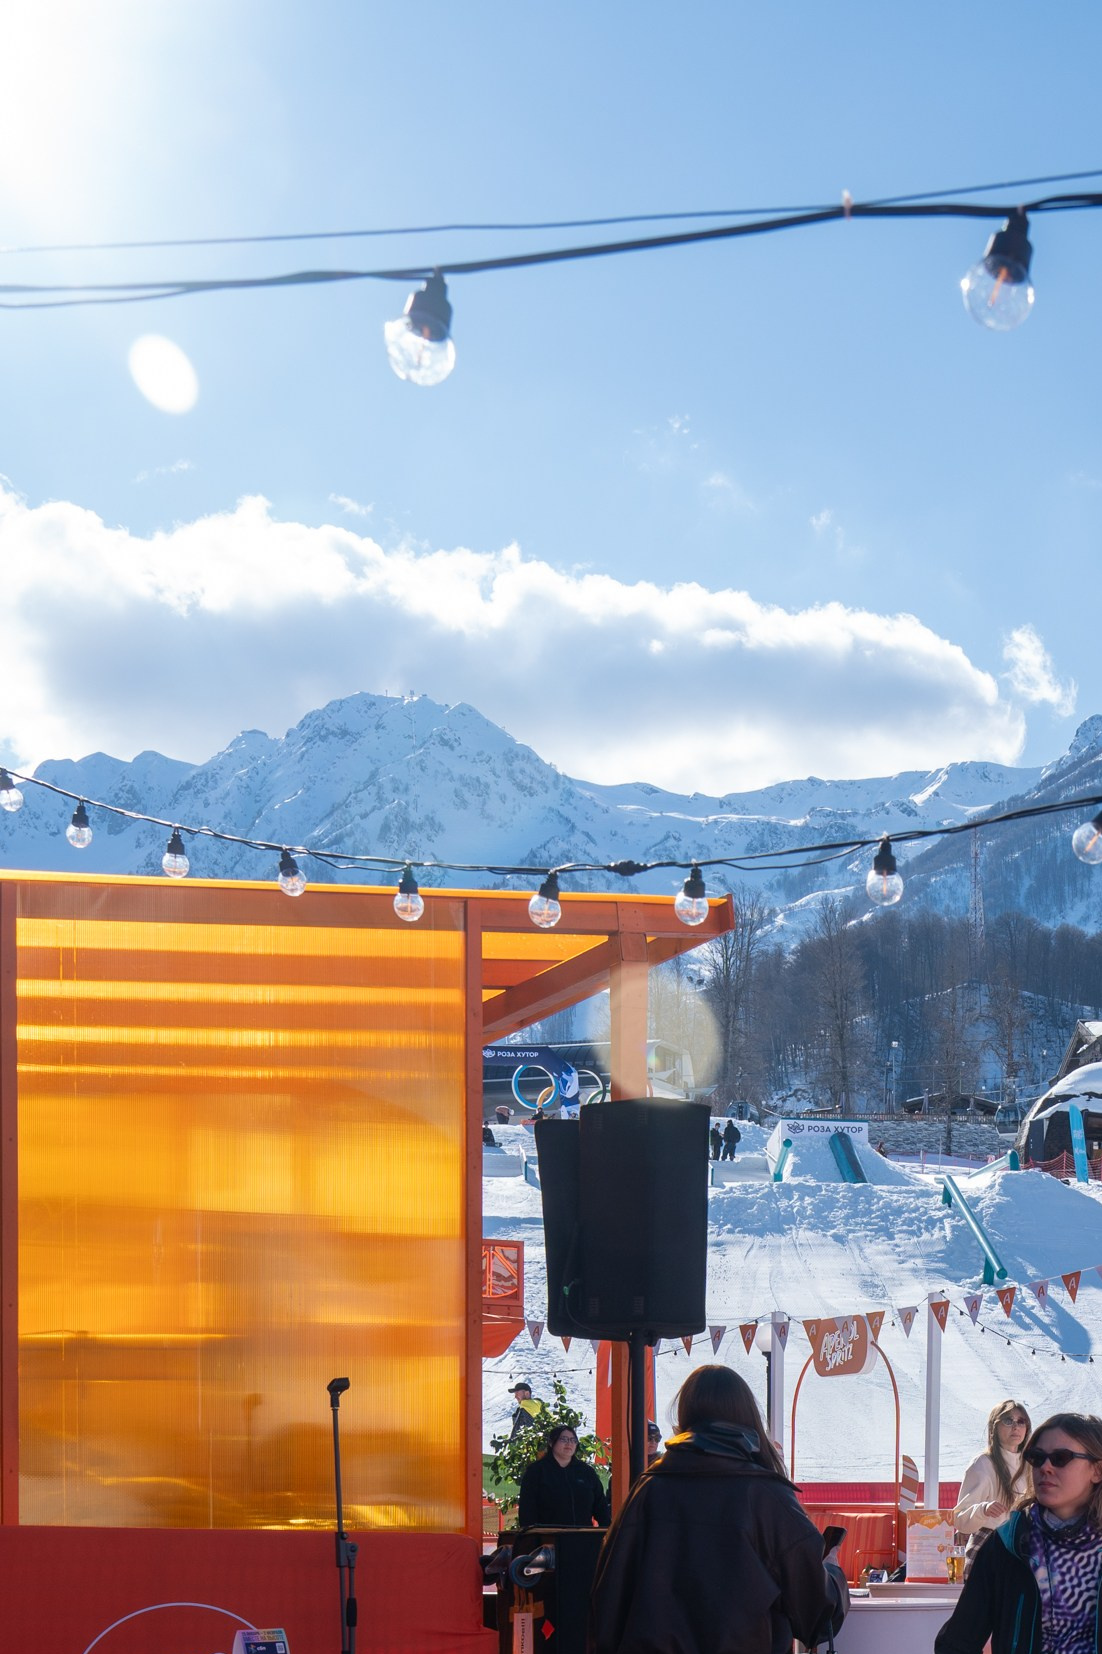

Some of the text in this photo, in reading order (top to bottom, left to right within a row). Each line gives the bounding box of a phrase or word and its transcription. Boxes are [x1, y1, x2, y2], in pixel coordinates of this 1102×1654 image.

[807, 1125, 863, 1134] РОЗА ХУТОР
[1068, 1276, 1076, 1289] A
[1037, 1285, 1046, 1298] A
[1003, 1292, 1011, 1304] A
[970, 1300, 978, 1312] A
[904, 1312, 912, 1323] A
[938, 1306, 946, 1319] A
[842, 1320, 849, 1332] A
[872, 1316, 880, 1328] A
[533, 1325, 540, 1338] A
[713, 1329, 721, 1341] A
[745, 1328, 752, 1340] A
[779, 1325, 786, 1338] A
[809, 1324, 816, 1336] A
